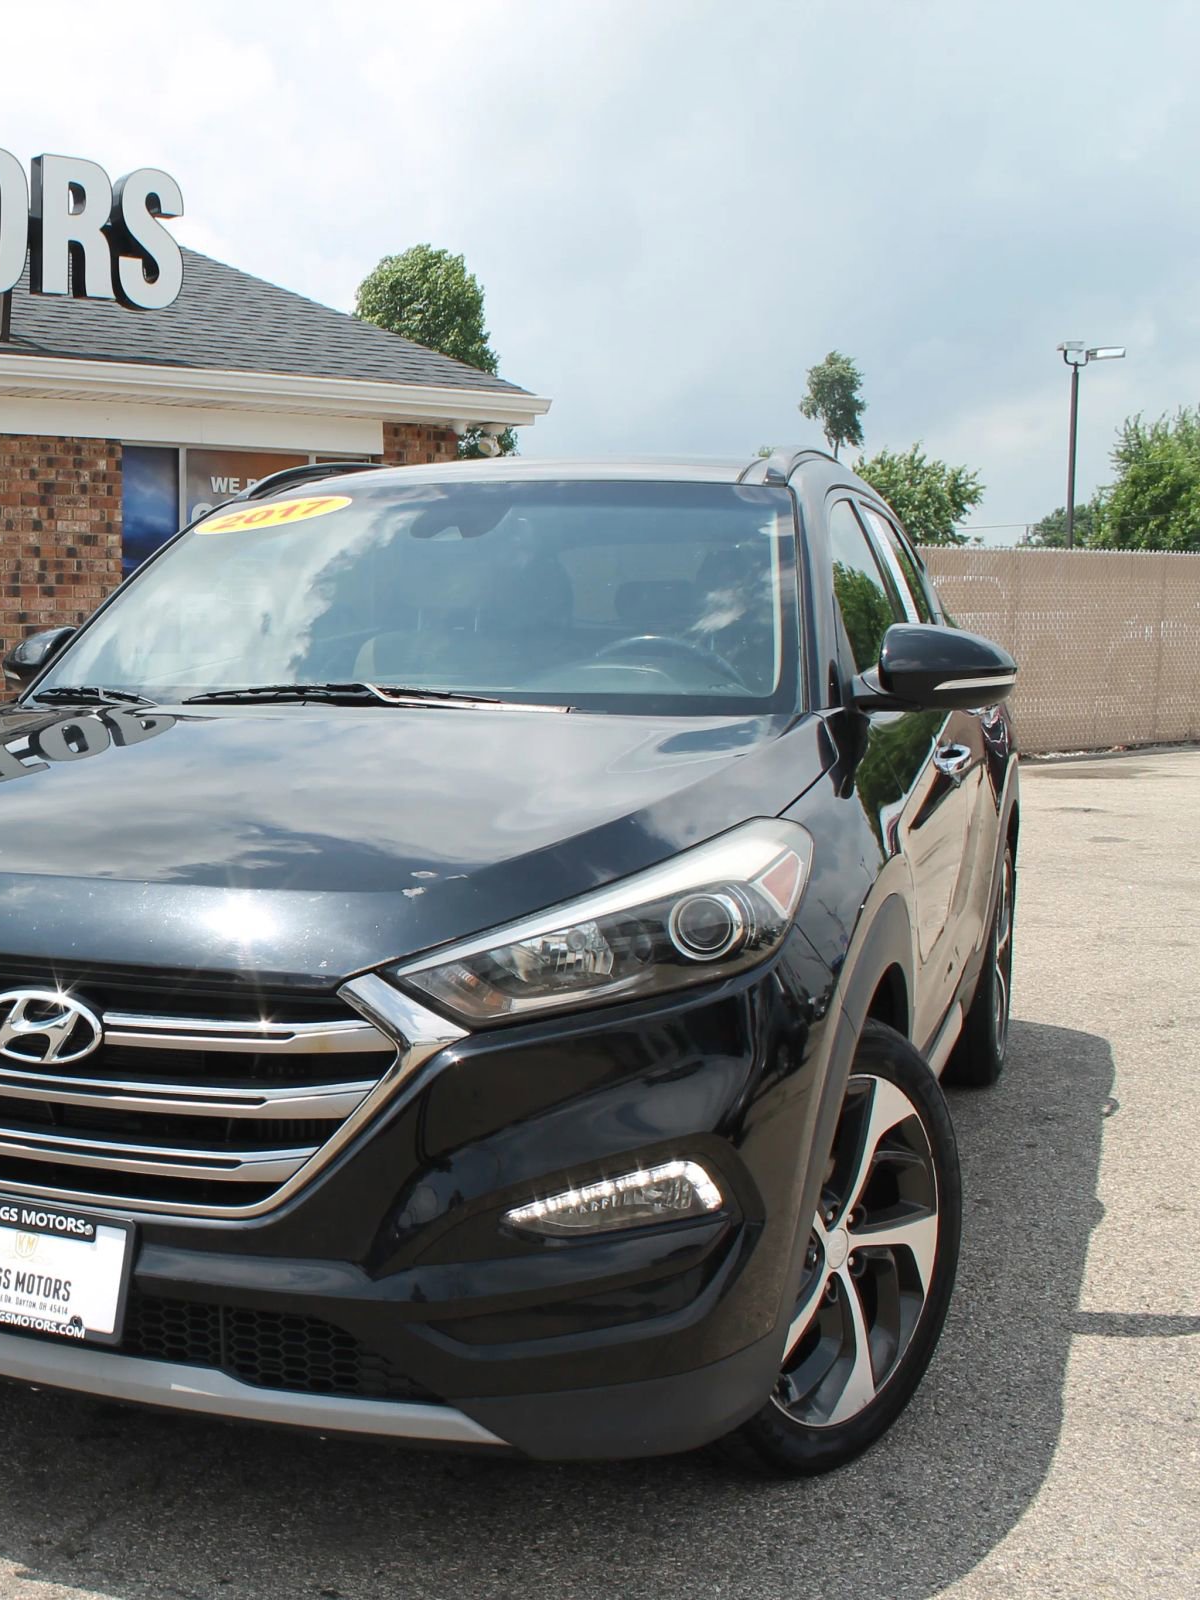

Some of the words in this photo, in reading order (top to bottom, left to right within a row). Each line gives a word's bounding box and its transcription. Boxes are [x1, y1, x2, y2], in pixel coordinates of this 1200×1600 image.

[210, 476, 240, 494] WE
[212, 499, 335, 531] 2017
[21, 1209, 85, 1234] MOTORS
[14, 1270, 73, 1302] MOTORS
